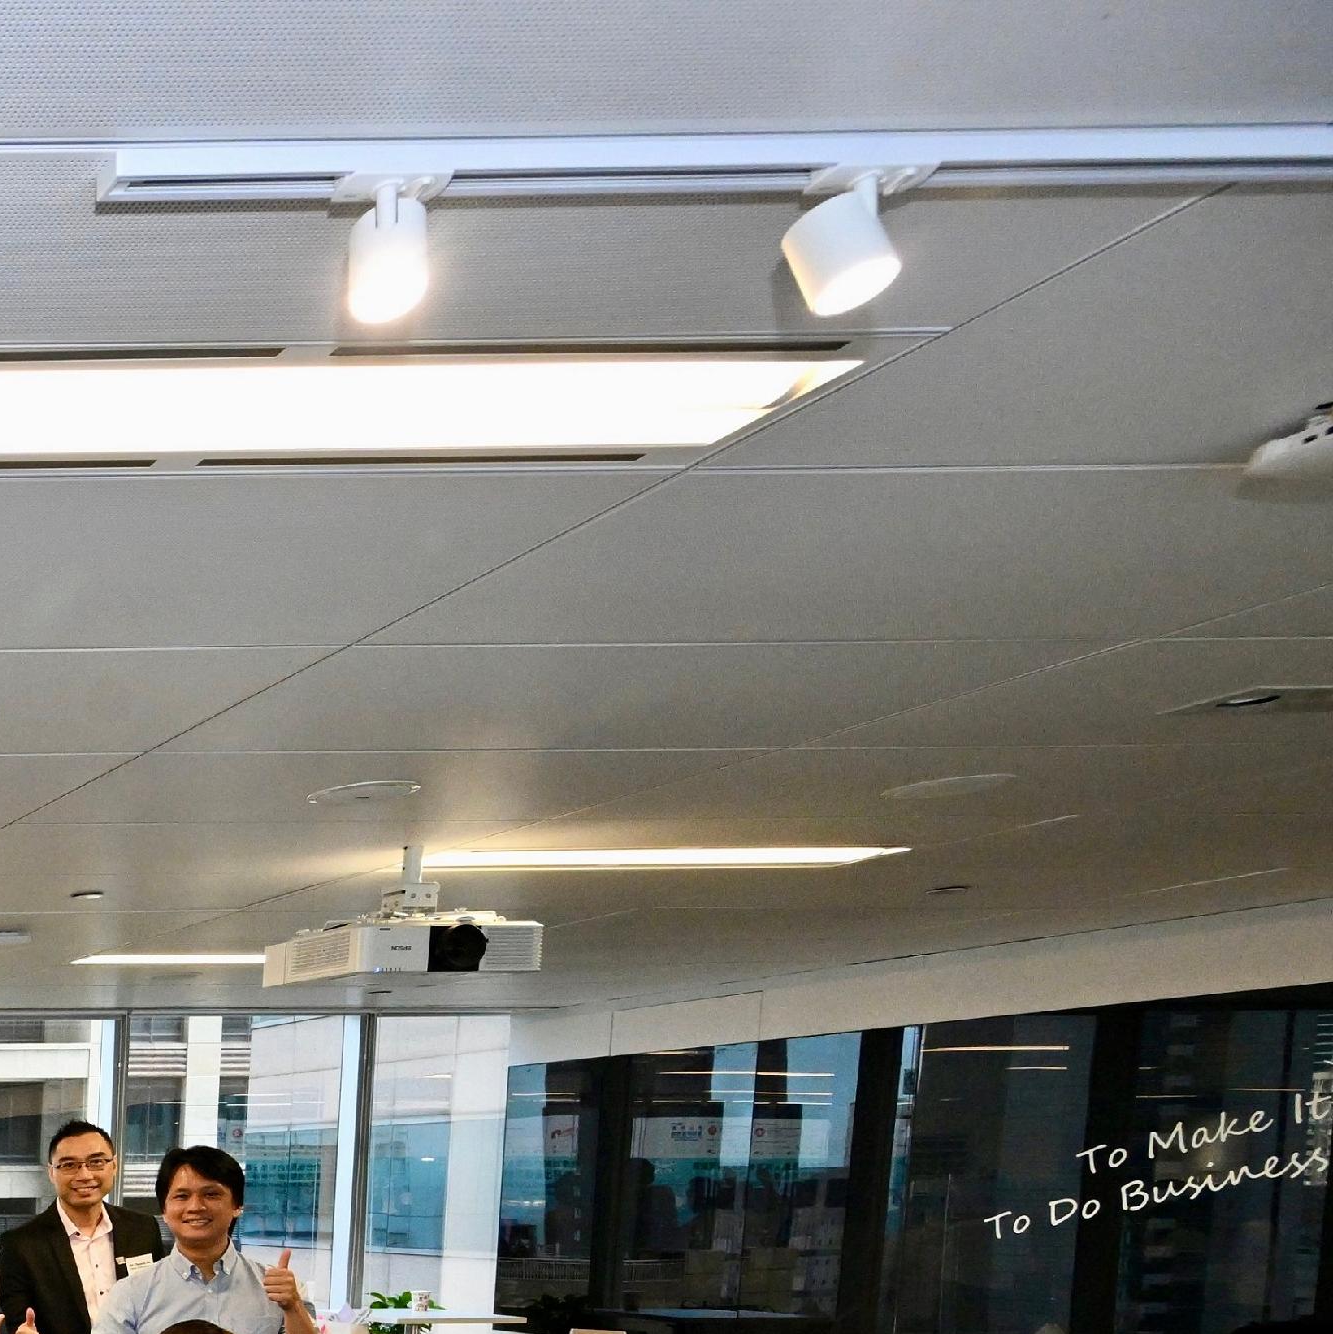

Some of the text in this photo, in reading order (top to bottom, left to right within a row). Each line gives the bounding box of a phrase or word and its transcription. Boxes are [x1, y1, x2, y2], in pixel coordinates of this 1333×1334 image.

[1076, 1093, 1333, 1174] To Make It
[983, 1147, 1329, 1239] To Do Business
